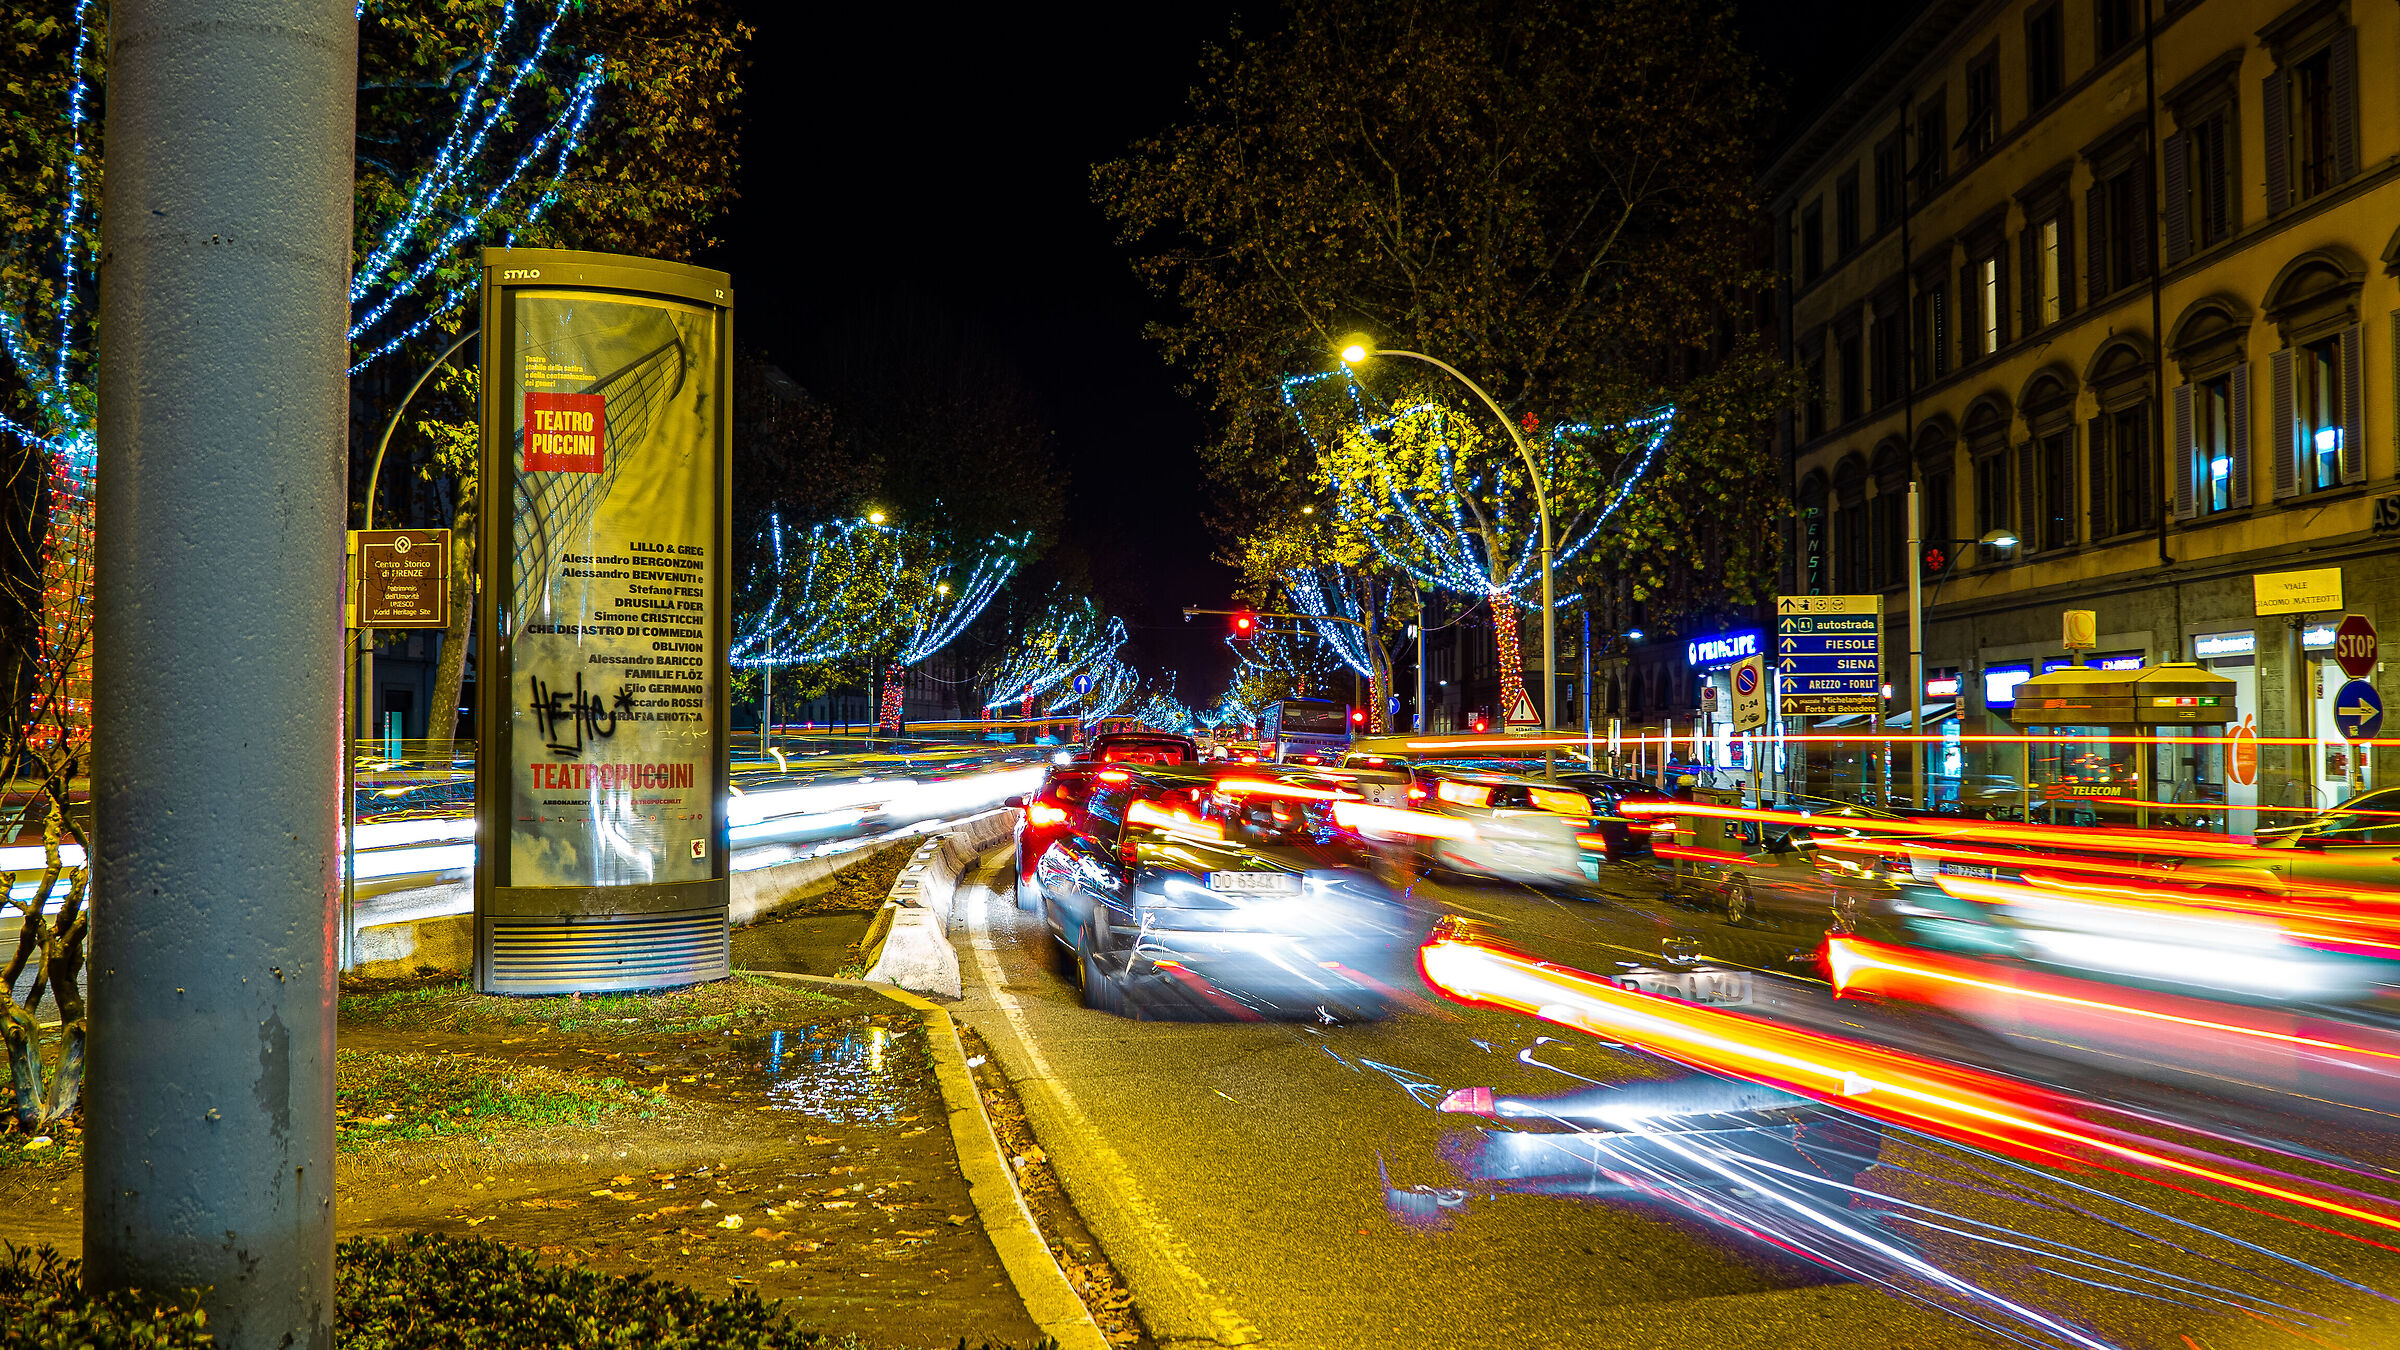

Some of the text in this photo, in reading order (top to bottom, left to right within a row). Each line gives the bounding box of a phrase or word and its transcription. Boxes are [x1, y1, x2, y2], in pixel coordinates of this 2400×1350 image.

[504, 269, 540, 280] STYLO
[714, 289, 724, 299] 12
[534, 410, 593, 432] TEATRO
[532, 434, 595, 456] PUCCINI
[630, 542, 704, 556] LILLO & GREG
[375, 560, 431, 568] Centro Storico
[562, 554, 703, 570] Alessandro BERGONZONI
[562, 568, 630, 579] Alessandro
[632, 570, 696, 583] BENVENUTI
[628, 584, 703, 597] Stefano FRESI
[2284, 582, 2307, 590] VIALE
[615, 598, 703, 611] DRUSILLA FOER
[2257, 594, 2340, 607] GIACOMO MATTEOTTI
[594, 611, 703, 625] Simone CRISTICCHI
[1800, 620, 1874, 629] A1 autostrada
[527, 624, 703, 638] CHE DISASTRO DI COMMEDIA
[652, 642, 703, 652] OBLIVION
[1825, 640, 1875, 649] FIESOLE
[2339, 634, 2375, 657] STOP
[589, 654, 703, 666] Alessandro BARICCO
[1837, 659, 1875, 669] SIENA
[625, 669, 674, 679] FAMILIE
[624, 684, 703, 694] Elio GERMANO
[1809, 680, 1840, 689] AREZZO
[622, 698, 703, 708] ccardo ROSSI
[1822, 696, 1876, 704] Michelangiolo
[656, 712, 703, 722] EROTICA
[530, 763, 694, 789] TEATROPUCCINI
[2072, 786, 2121, 796] TELECOM
